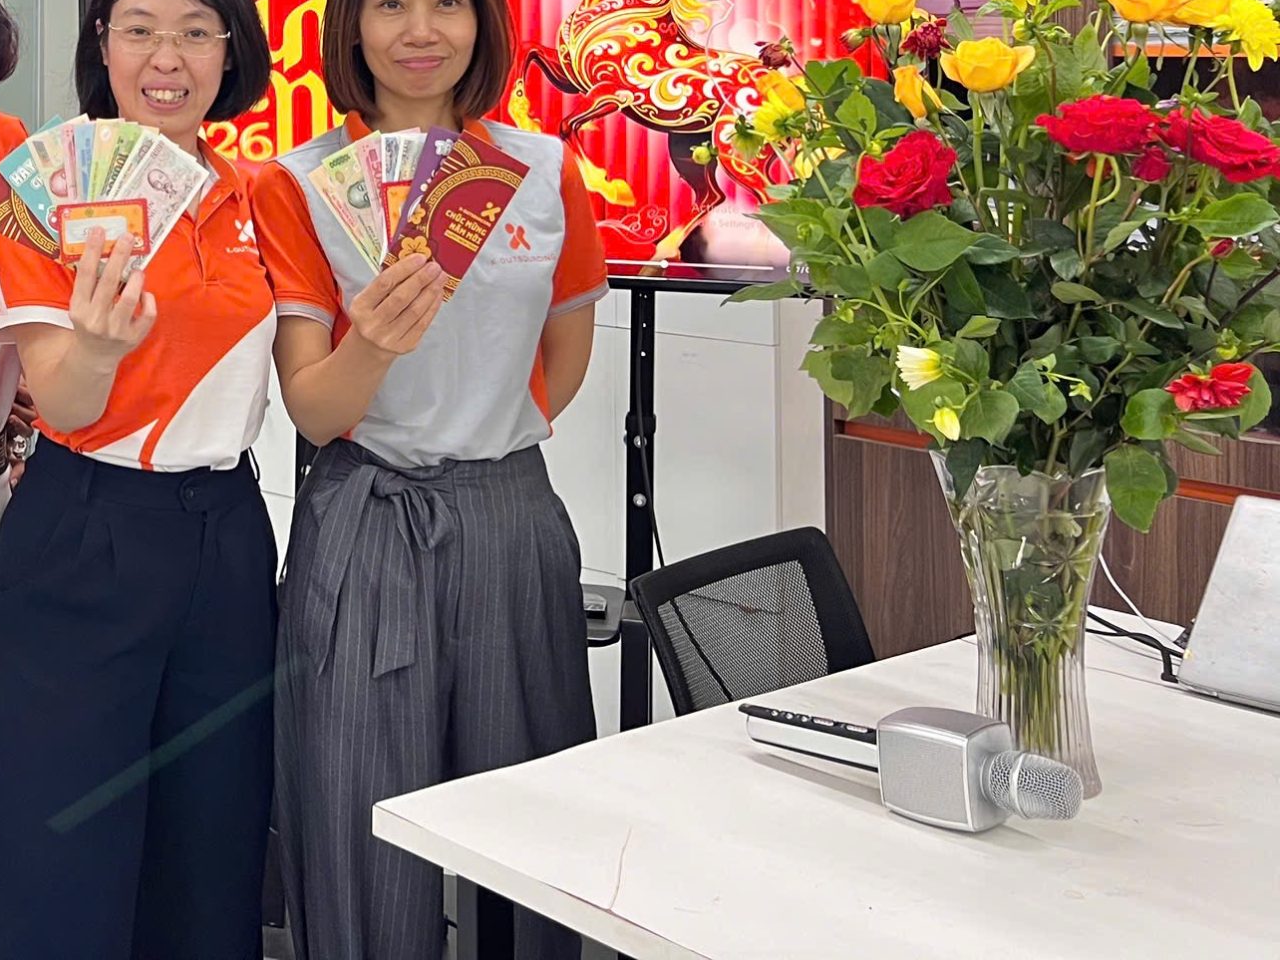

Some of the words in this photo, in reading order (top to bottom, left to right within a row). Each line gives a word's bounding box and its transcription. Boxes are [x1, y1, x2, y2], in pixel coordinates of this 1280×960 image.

[197, 121, 273, 162] 26
[445, 208, 466, 225] CHÚC
[465, 217, 488, 237] MỪNG
[448, 221, 467, 236] NĂM
